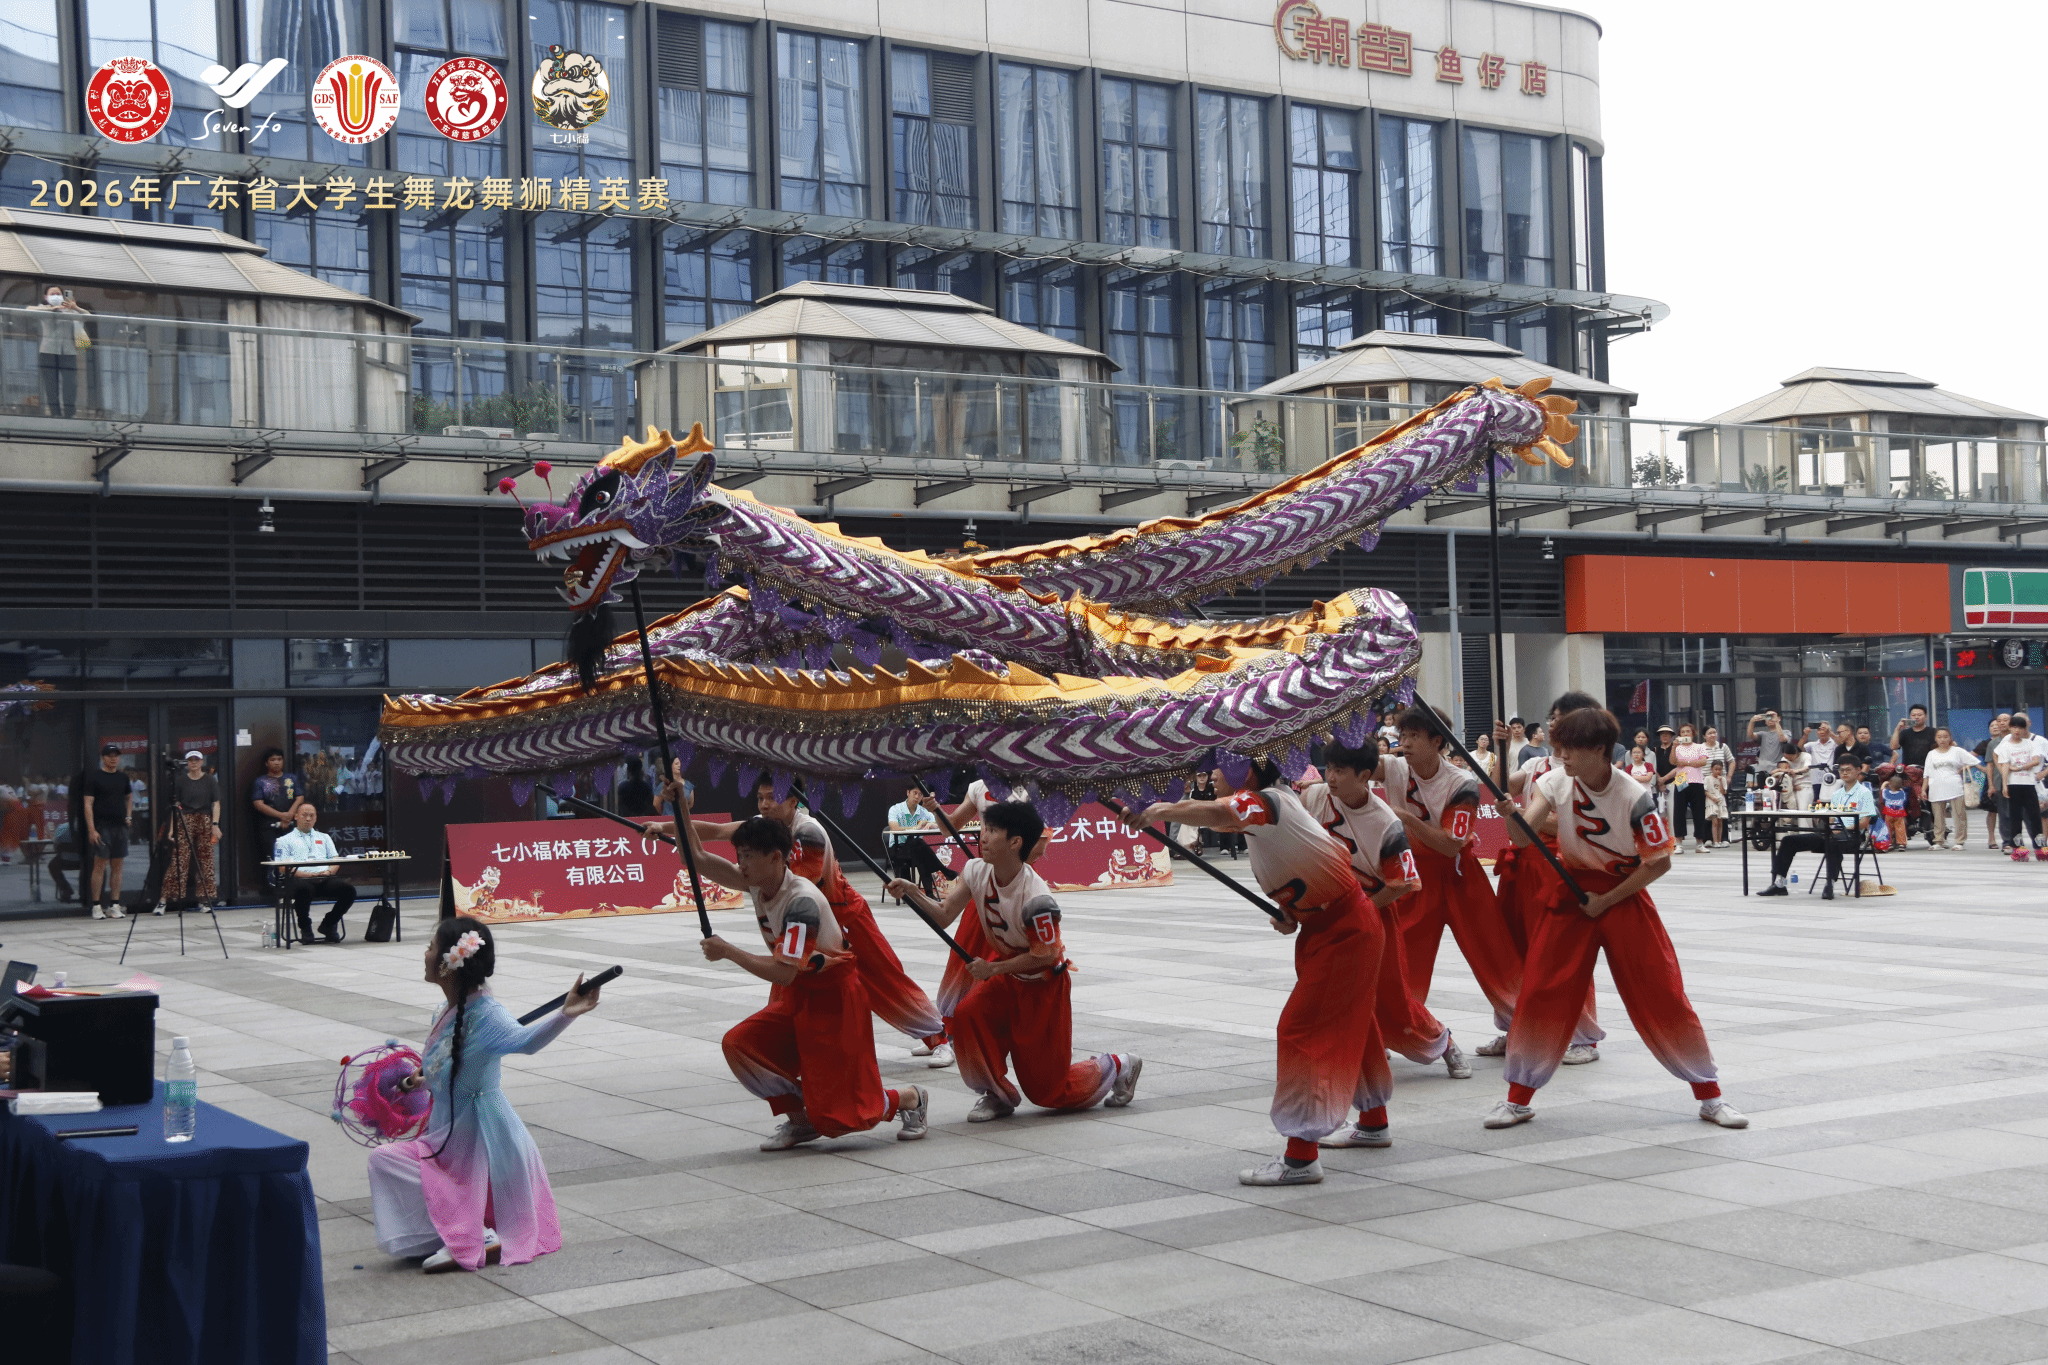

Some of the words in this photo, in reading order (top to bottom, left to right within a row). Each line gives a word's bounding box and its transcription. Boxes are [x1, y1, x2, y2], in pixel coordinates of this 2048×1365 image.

[1453, 812, 1469, 838] 8
[1642, 813, 1663, 844] 3
[566, 863, 645, 887] 有限公司
[1402, 851, 1417, 878] 2
[787, 925, 800, 955] 1
[1035, 914, 1054, 943] 5
